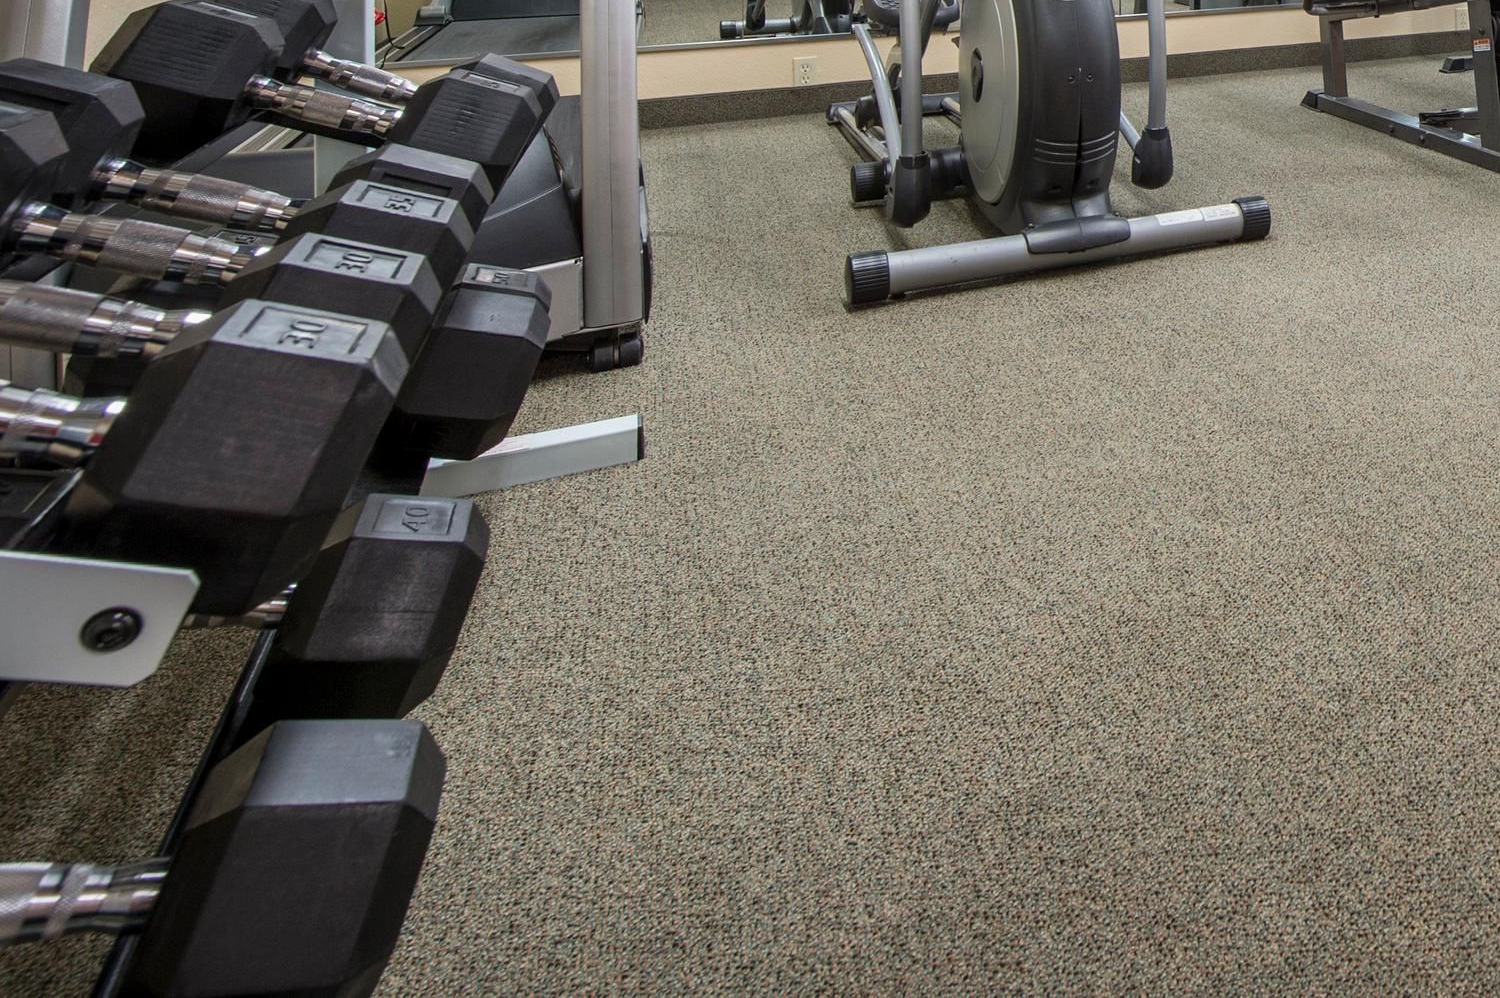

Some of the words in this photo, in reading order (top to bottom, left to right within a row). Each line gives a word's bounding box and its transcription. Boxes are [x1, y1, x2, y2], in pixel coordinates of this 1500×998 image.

[333, 251, 374, 275] 30
[277, 319, 328, 350] 30
[401, 506, 430, 533] 40
